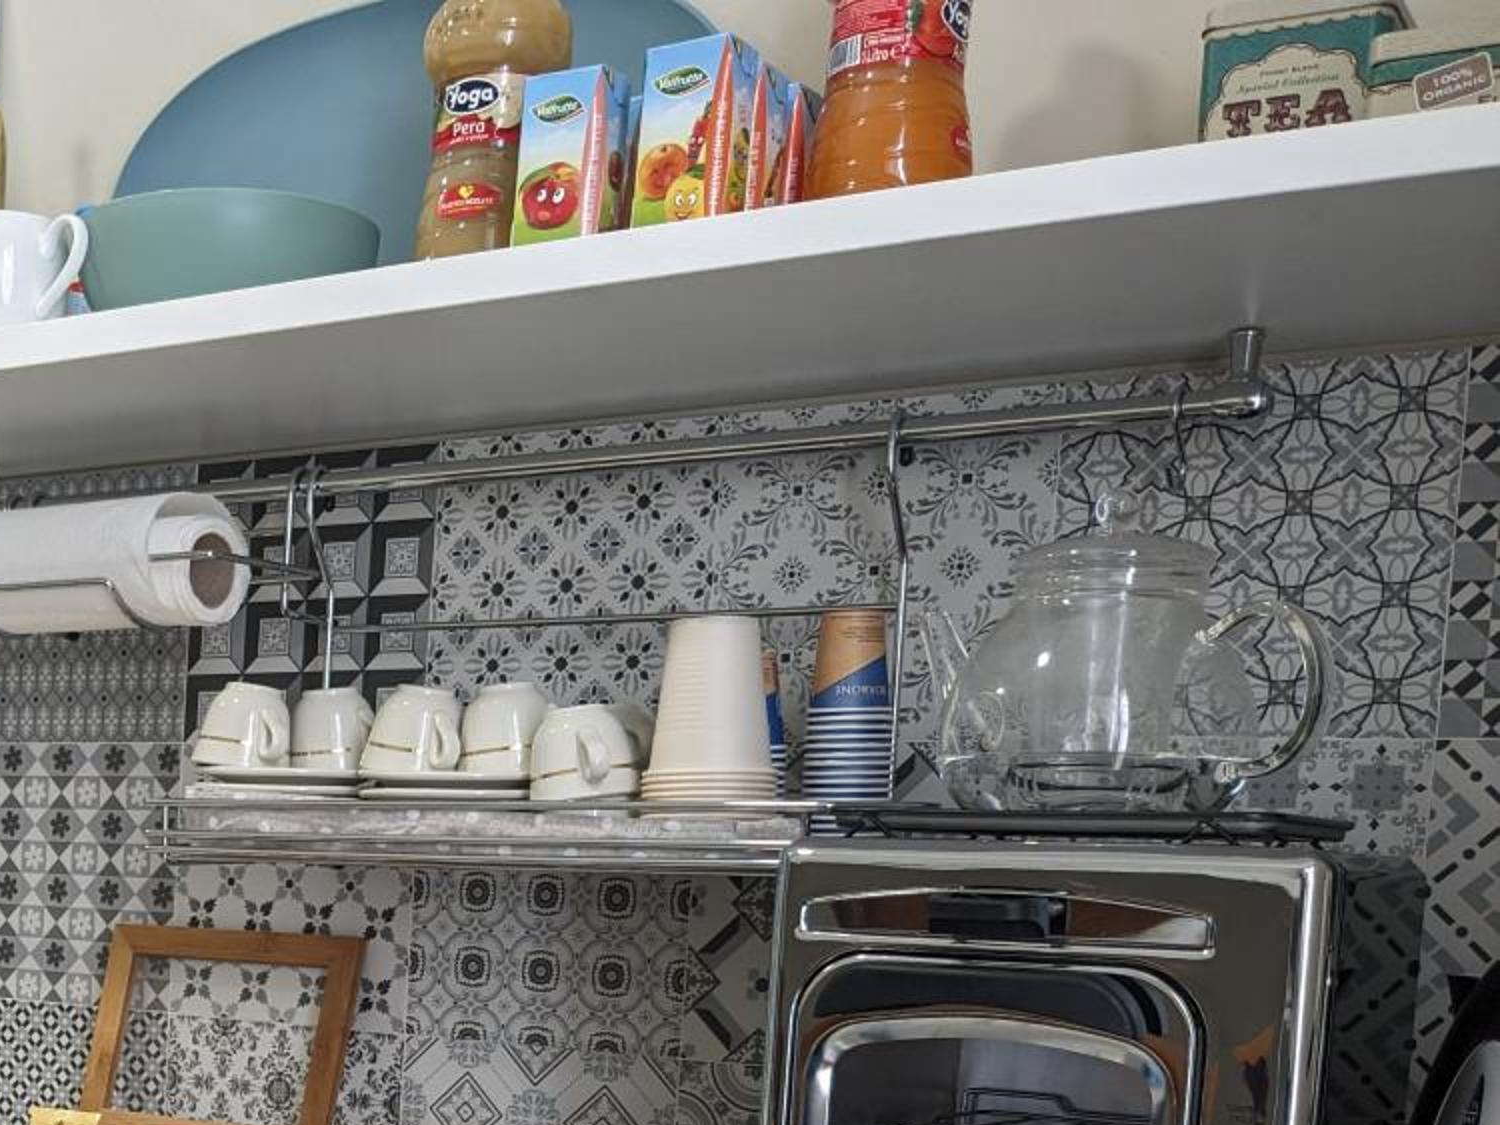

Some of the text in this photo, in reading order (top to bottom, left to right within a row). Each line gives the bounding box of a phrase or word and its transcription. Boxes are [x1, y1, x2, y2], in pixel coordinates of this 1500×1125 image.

[449, 86, 494, 109] Yoga
[1422, 74, 1487, 101] ORGANIC
[1223, 88, 1352, 137] TEA
[453, 121, 485, 137] Pera
